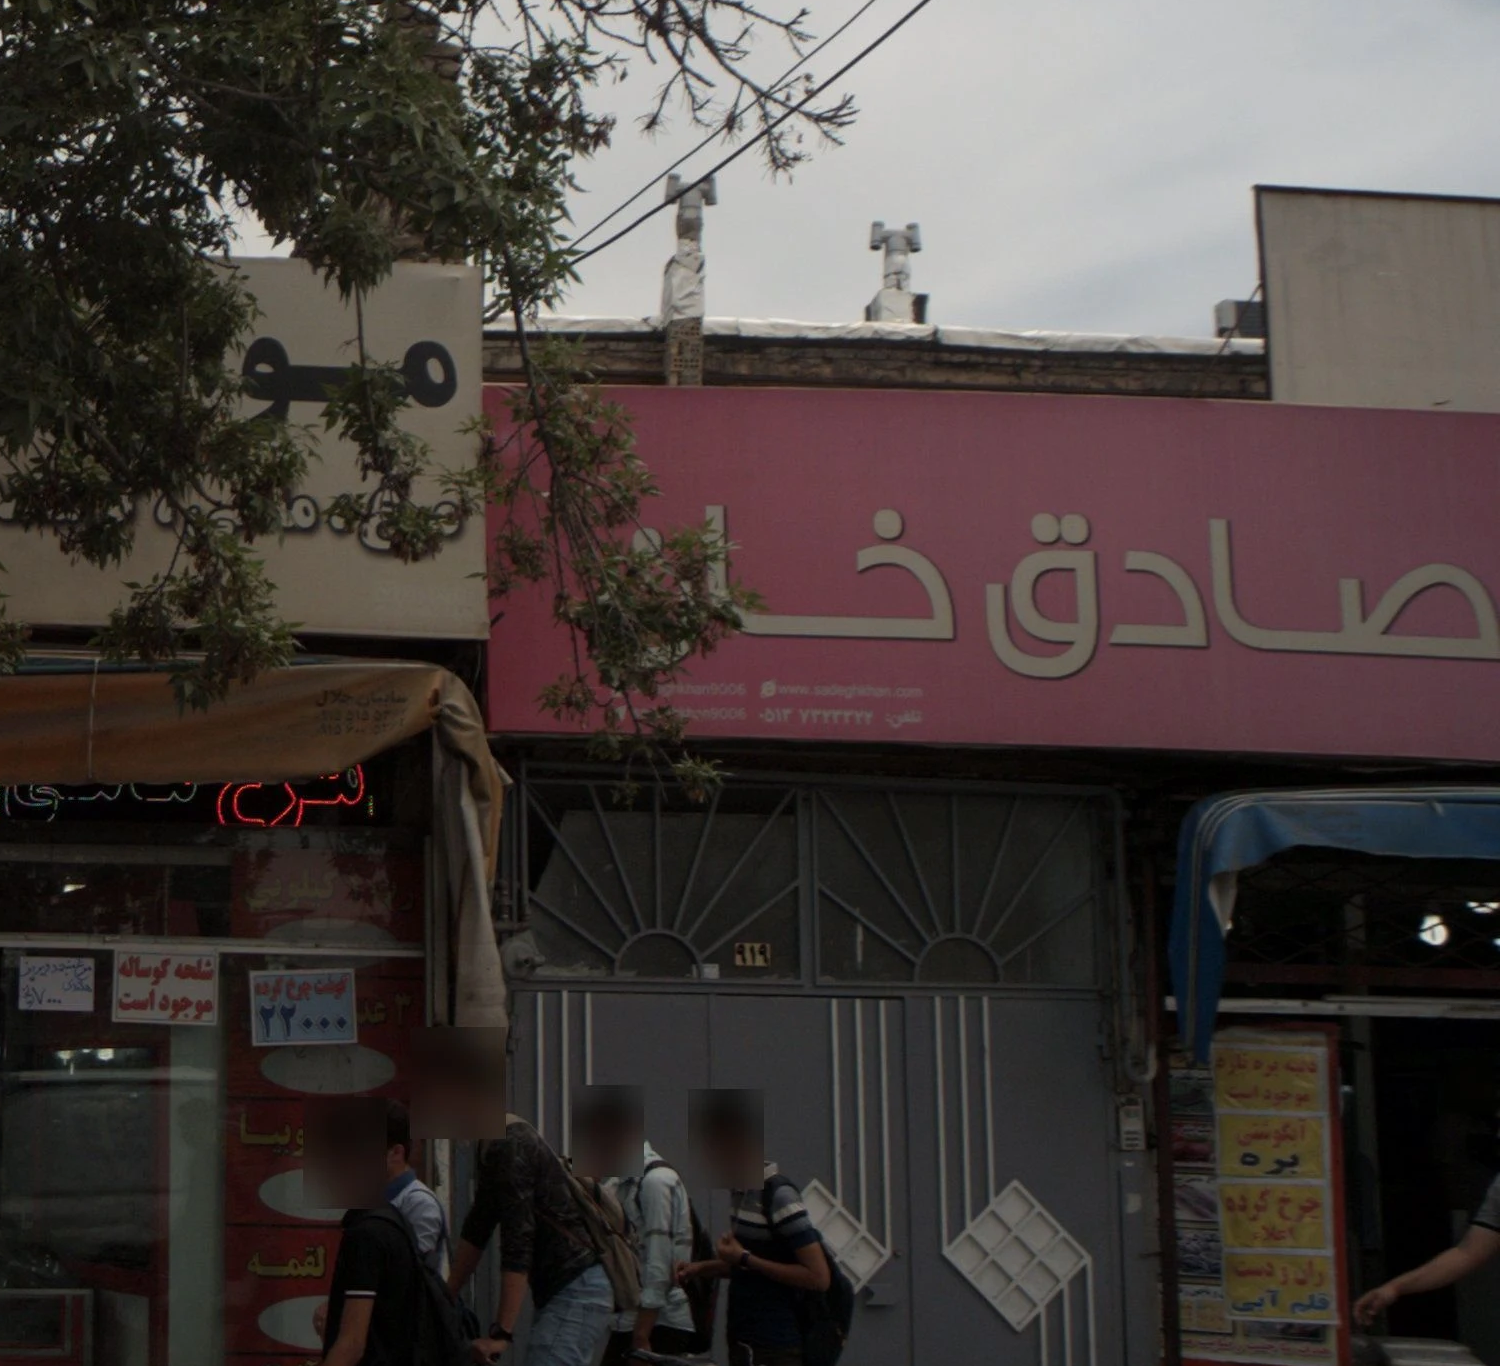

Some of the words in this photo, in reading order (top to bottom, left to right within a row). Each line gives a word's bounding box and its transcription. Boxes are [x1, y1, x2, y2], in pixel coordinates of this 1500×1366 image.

[736, 943, 769, 964] ۹۱۹
[119, 956, 171, 985] گوساله
[119, 988, 156, 1011] است
[159, 993, 214, 1020] موجود
[258, 1003, 348, 1039] ۲۲۰۰۰
[1227, 1084, 1260, 1099] است
[1263, 1088, 1311, 1107] موجود
[1240, 1151, 1301, 1176] بره
[1225, 1187, 1271, 1222] کرده
[246, 1244, 328, 1280] لقمه
[1289, 1292, 1331, 1315] قلم
